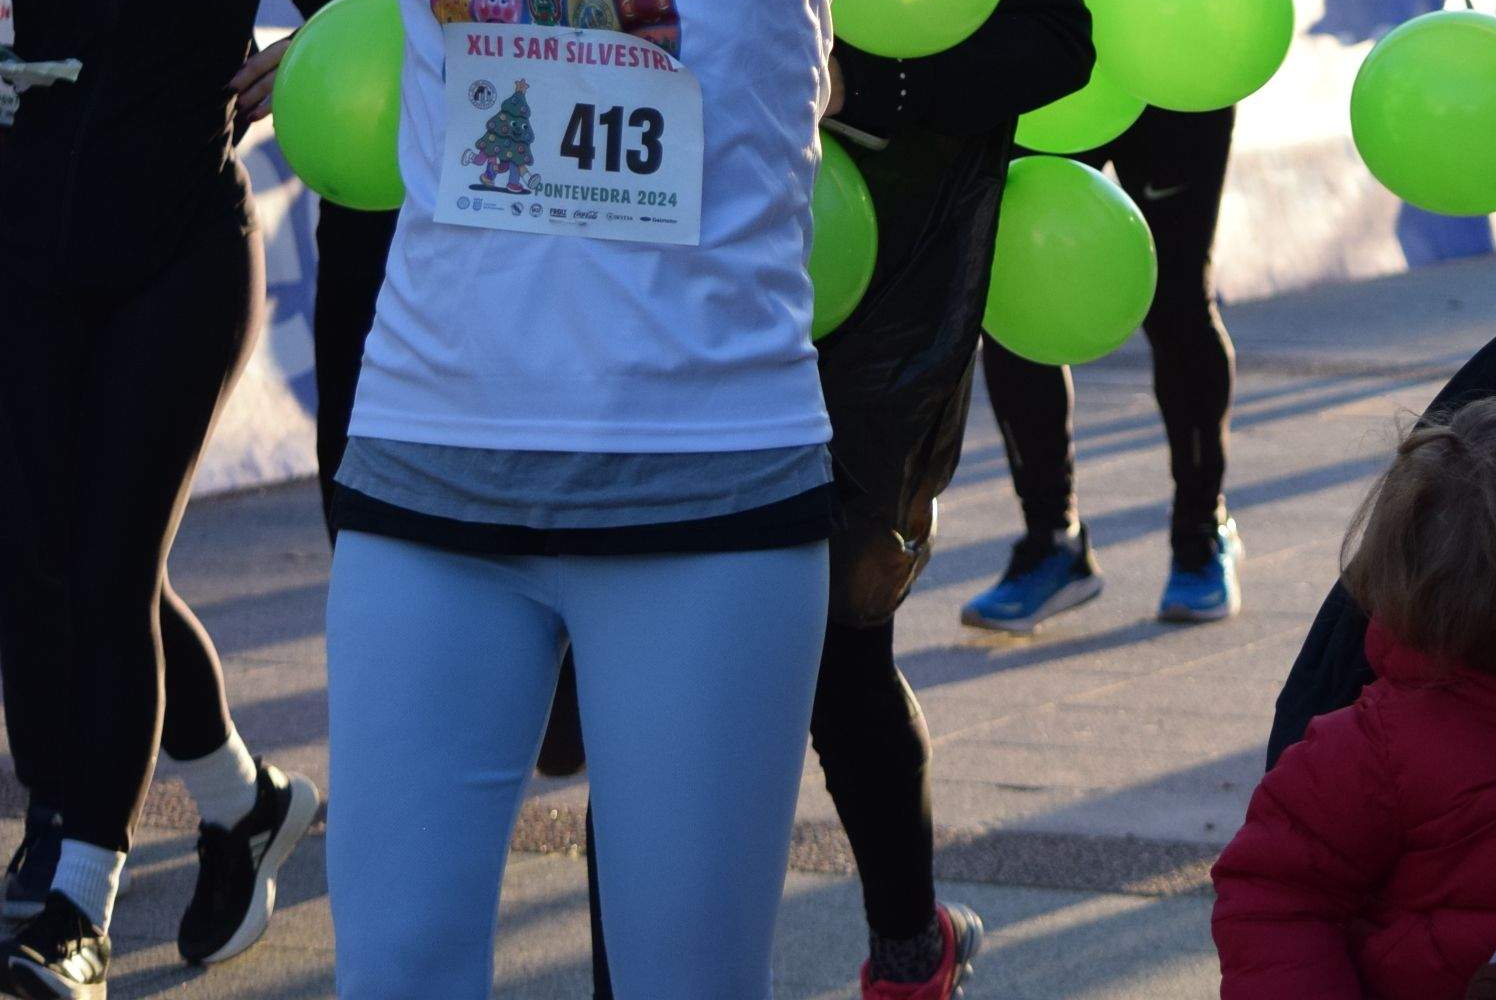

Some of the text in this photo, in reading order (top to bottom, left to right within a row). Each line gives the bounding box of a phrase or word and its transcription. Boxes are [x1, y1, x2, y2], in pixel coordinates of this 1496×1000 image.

[467, 35, 504, 57] XLI
[513, 36, 558, 61] SAN
[560, 102, 665, 175] 413
[534, 182, 678, 207] PONTEVEDRA 2024
